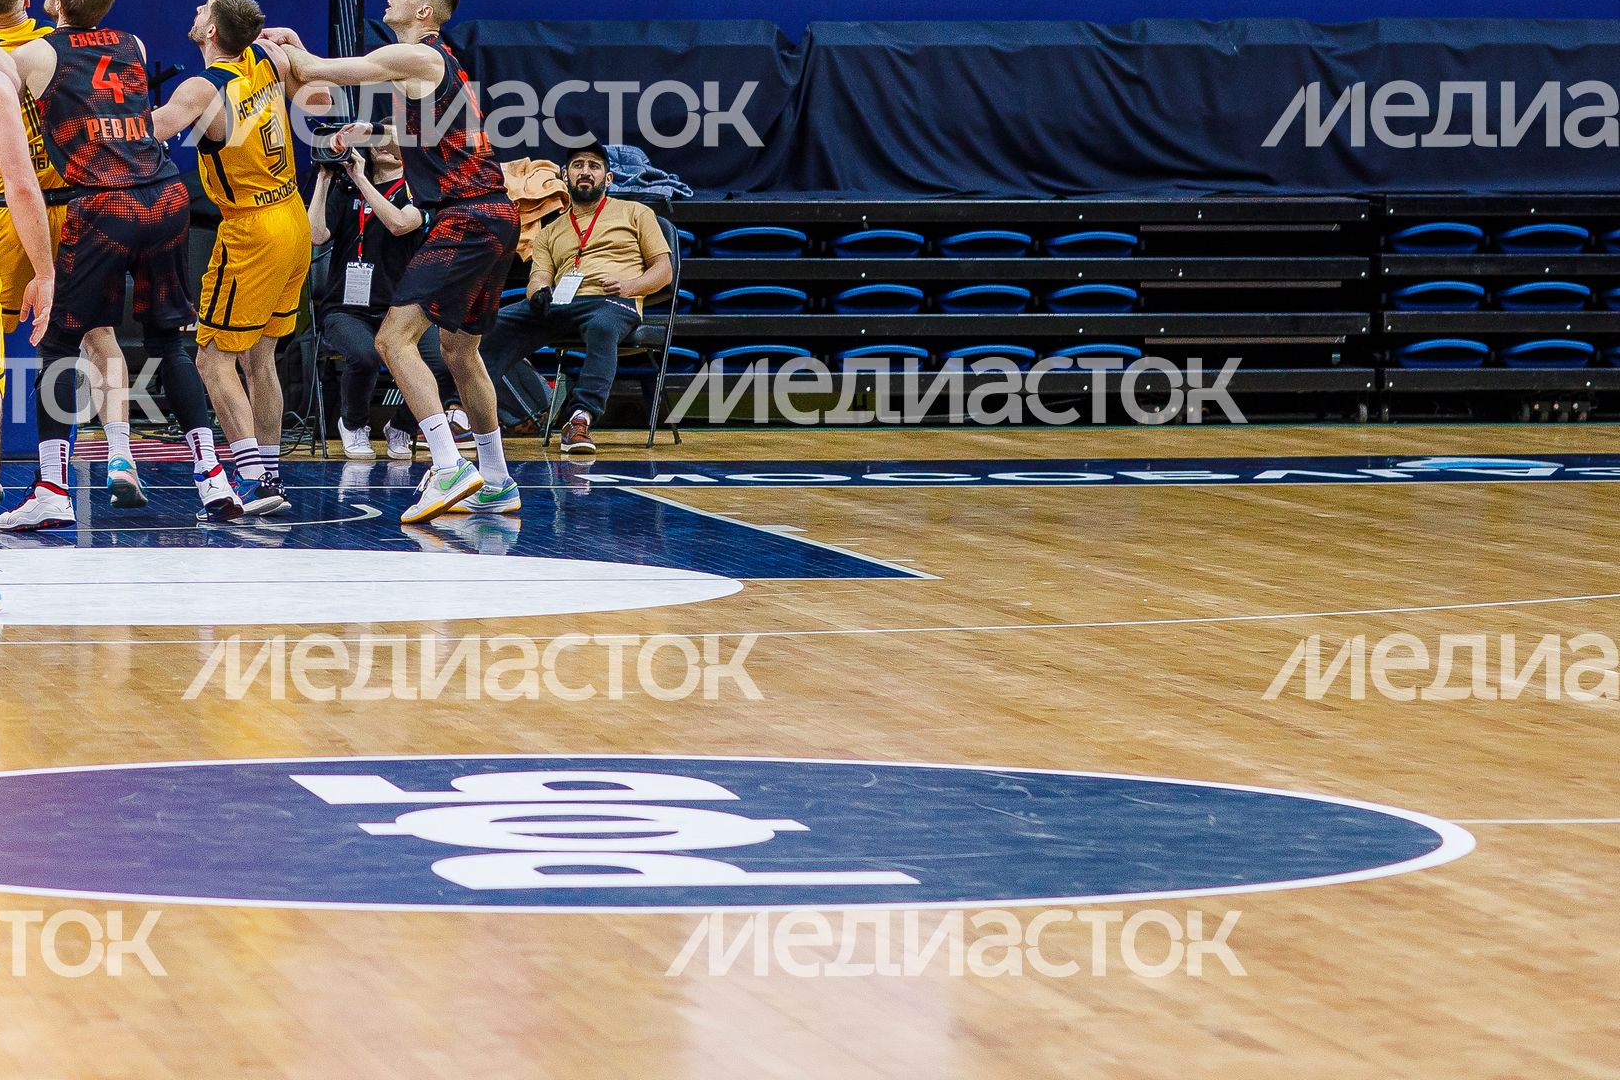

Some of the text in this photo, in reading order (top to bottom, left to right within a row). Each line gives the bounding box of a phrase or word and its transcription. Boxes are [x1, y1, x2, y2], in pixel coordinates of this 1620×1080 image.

[69, 30, 120, 48] ЕВСЕЕВ
[91, 55, 125, 104] 4
[86, 115, 150, 142] РЕВДА
[260, 113, 288, 177] 9
[287, 770, 921, 890] РФБ
